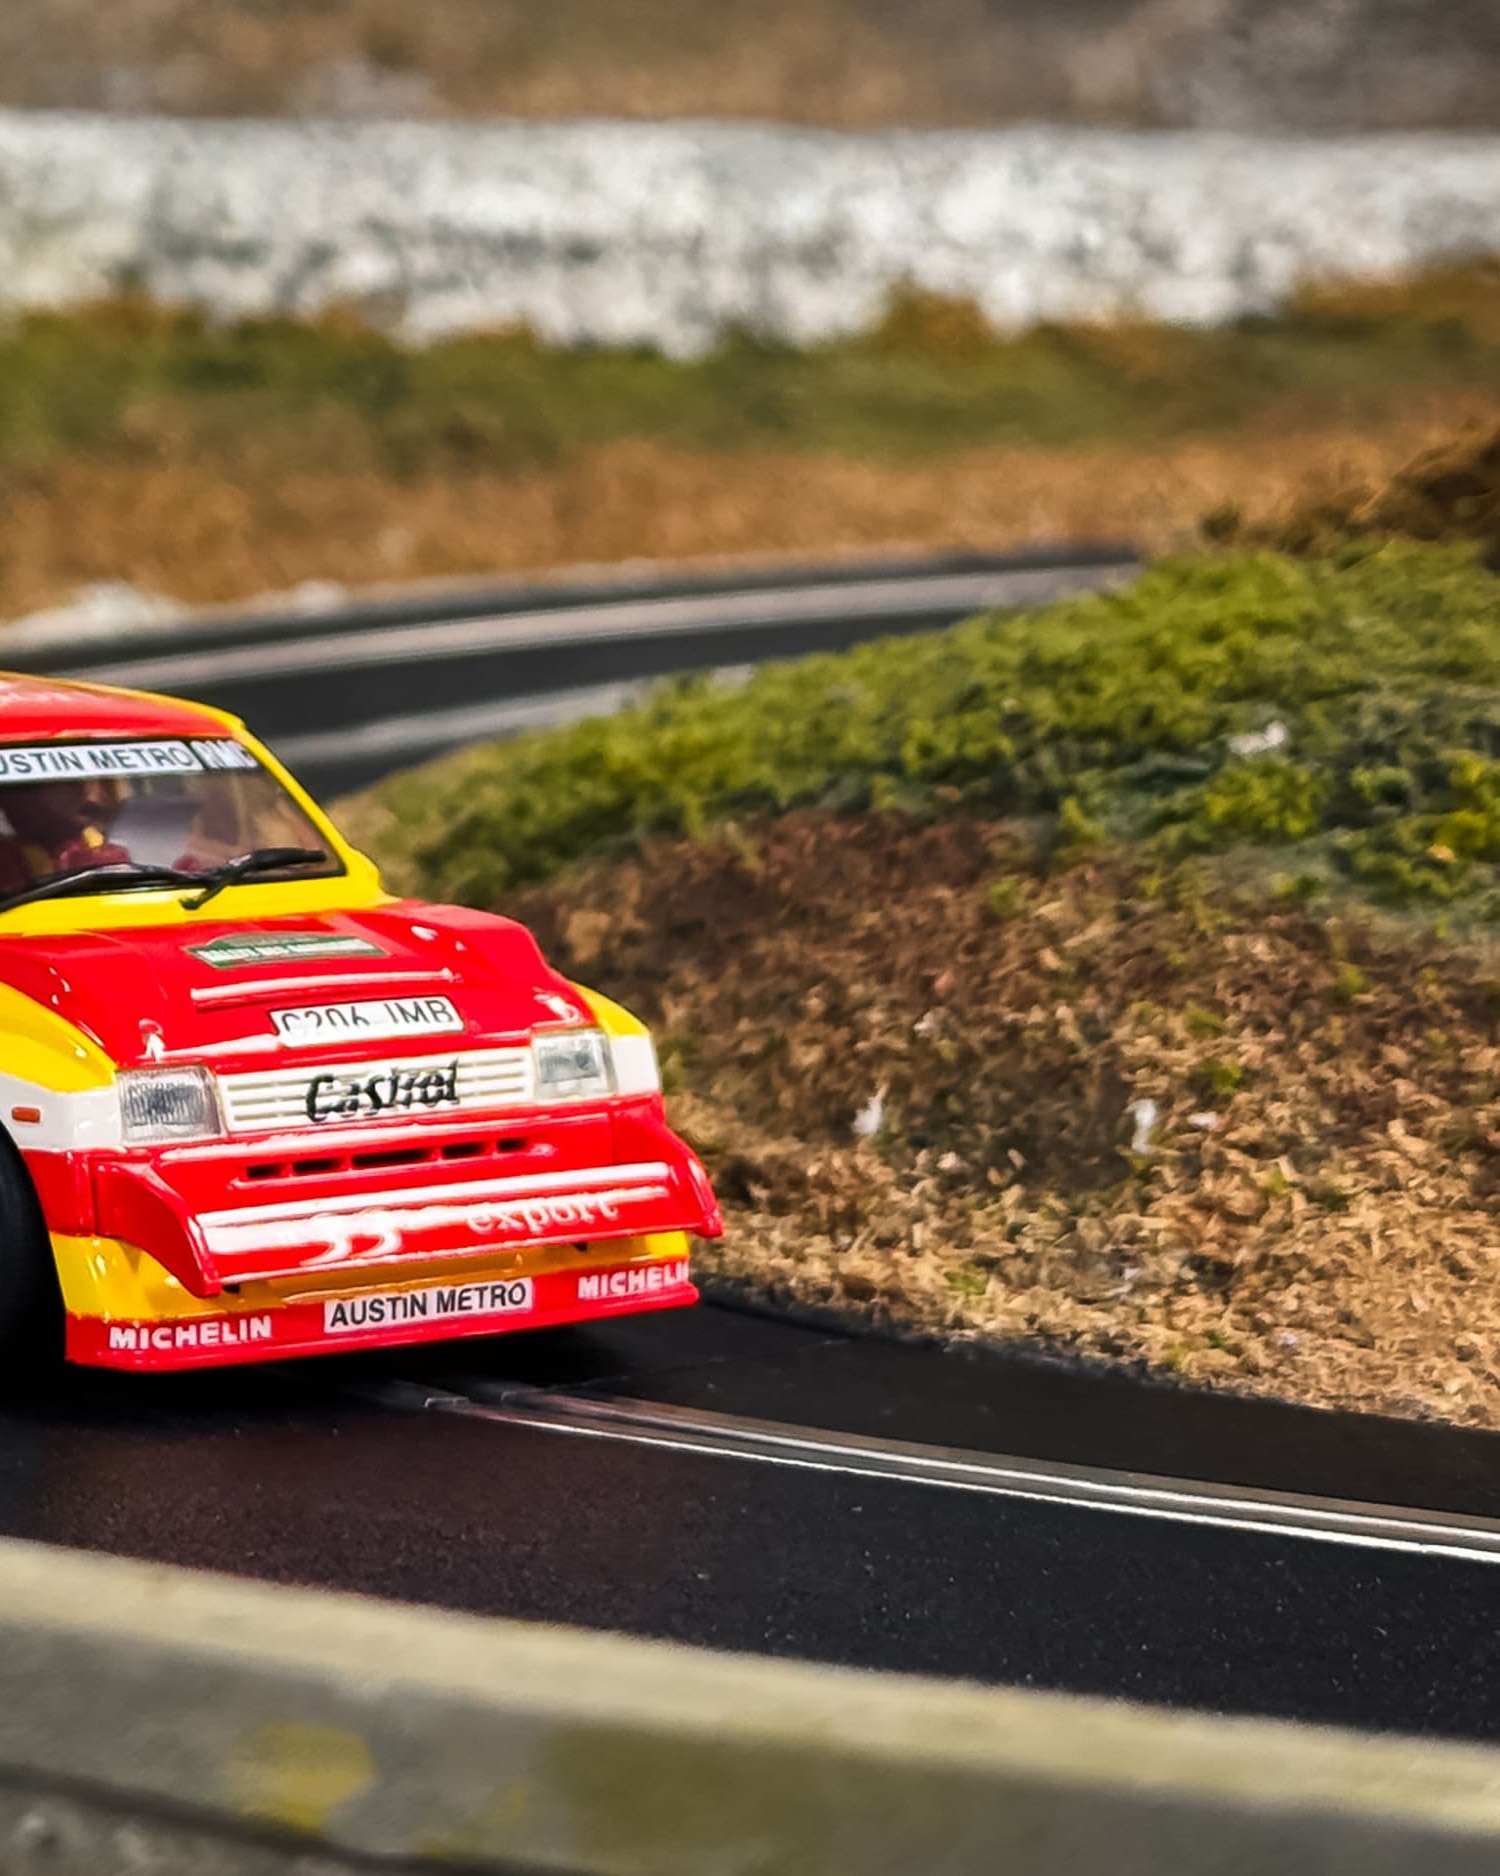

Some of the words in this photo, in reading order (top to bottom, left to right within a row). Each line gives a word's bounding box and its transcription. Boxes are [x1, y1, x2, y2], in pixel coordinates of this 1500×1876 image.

[88, 747, 194, 770] METRO
[306, 1057, 460, 1123] Castrol
[466, 1194, 622, 1234] export
[330, 1291, 428, 1328] AUSTIN
[436, 1281, 528, 1315] METRO
[109, 1314, 273, 1350] MICHELIN
